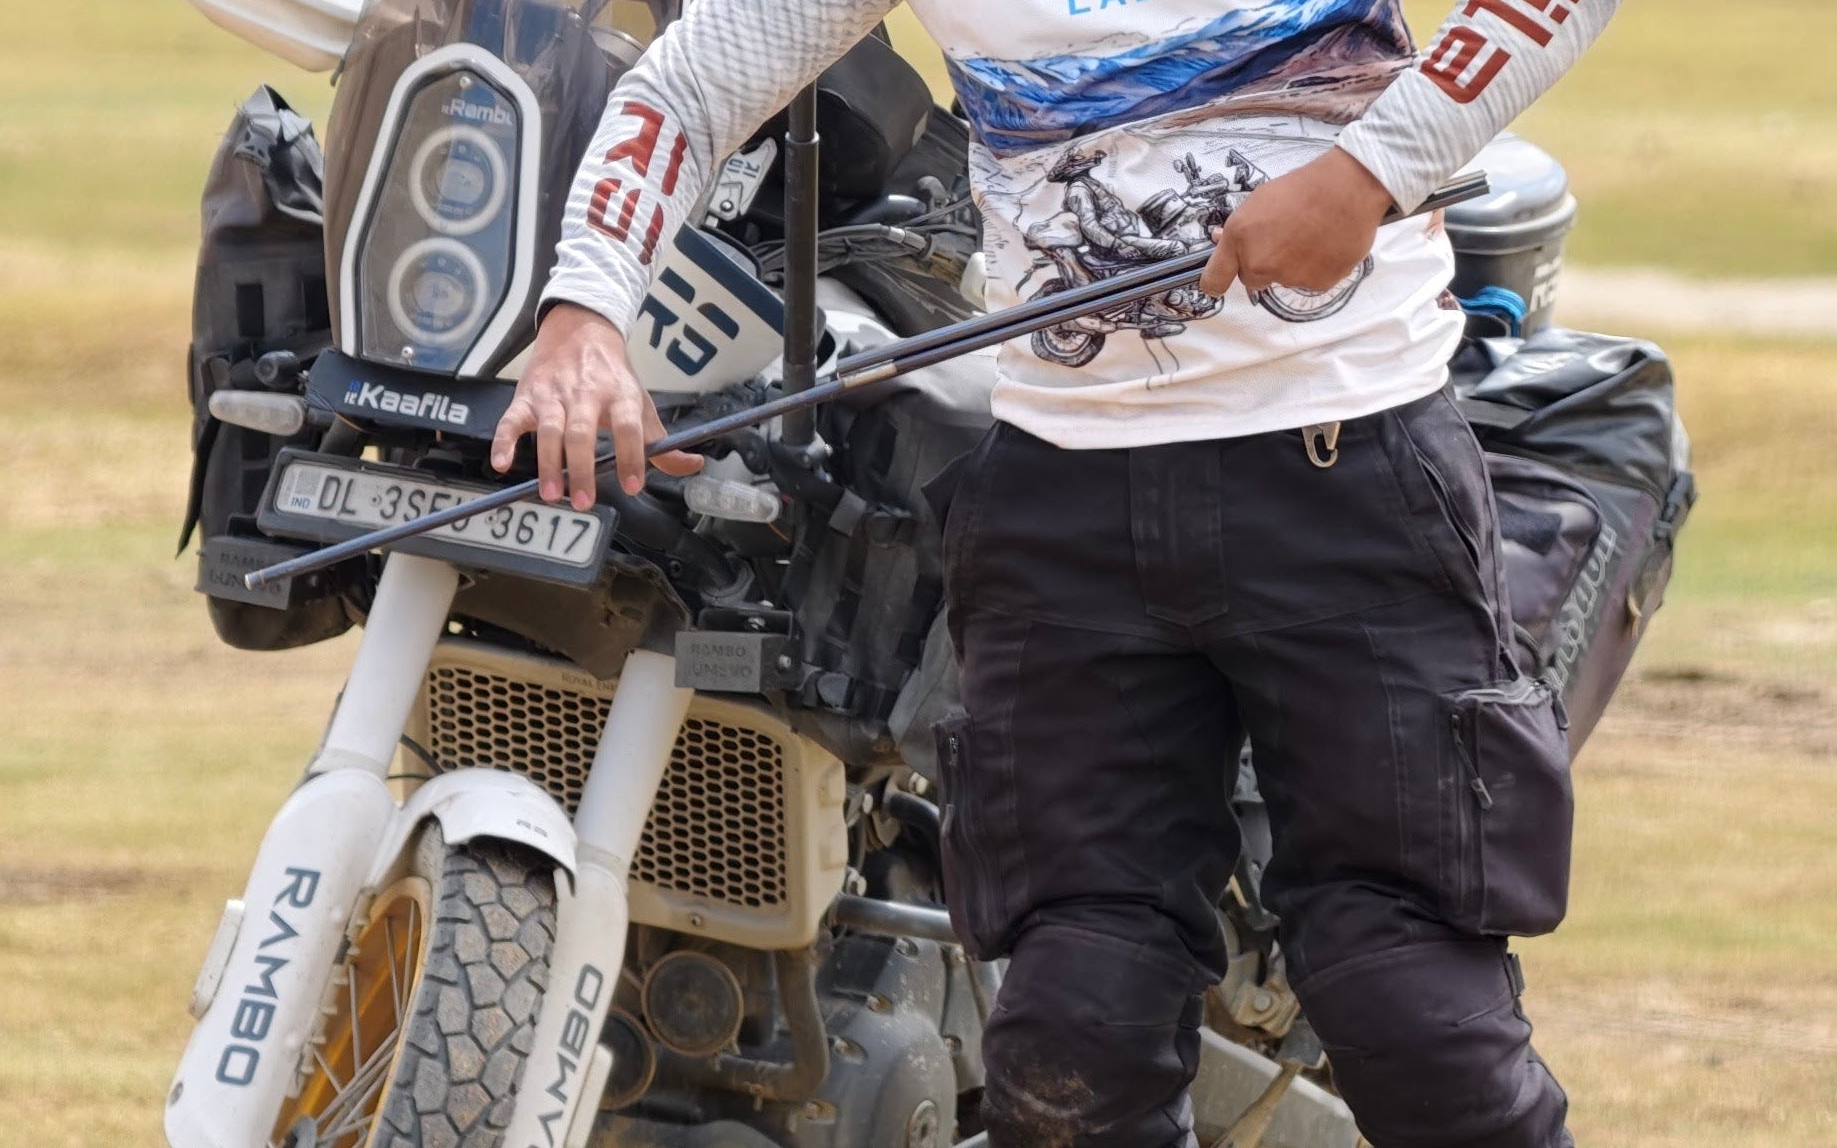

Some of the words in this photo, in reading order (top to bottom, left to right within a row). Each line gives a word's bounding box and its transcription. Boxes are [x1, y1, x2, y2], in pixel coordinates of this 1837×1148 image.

[357, 381, 470, 426] Kaafila
[317, 474, 356, 517] DL
[490, 505, 591, 555] 3617
[214, 865, 322, 1088] RAMBO
[525, 962, 604, 1148] AMBO
